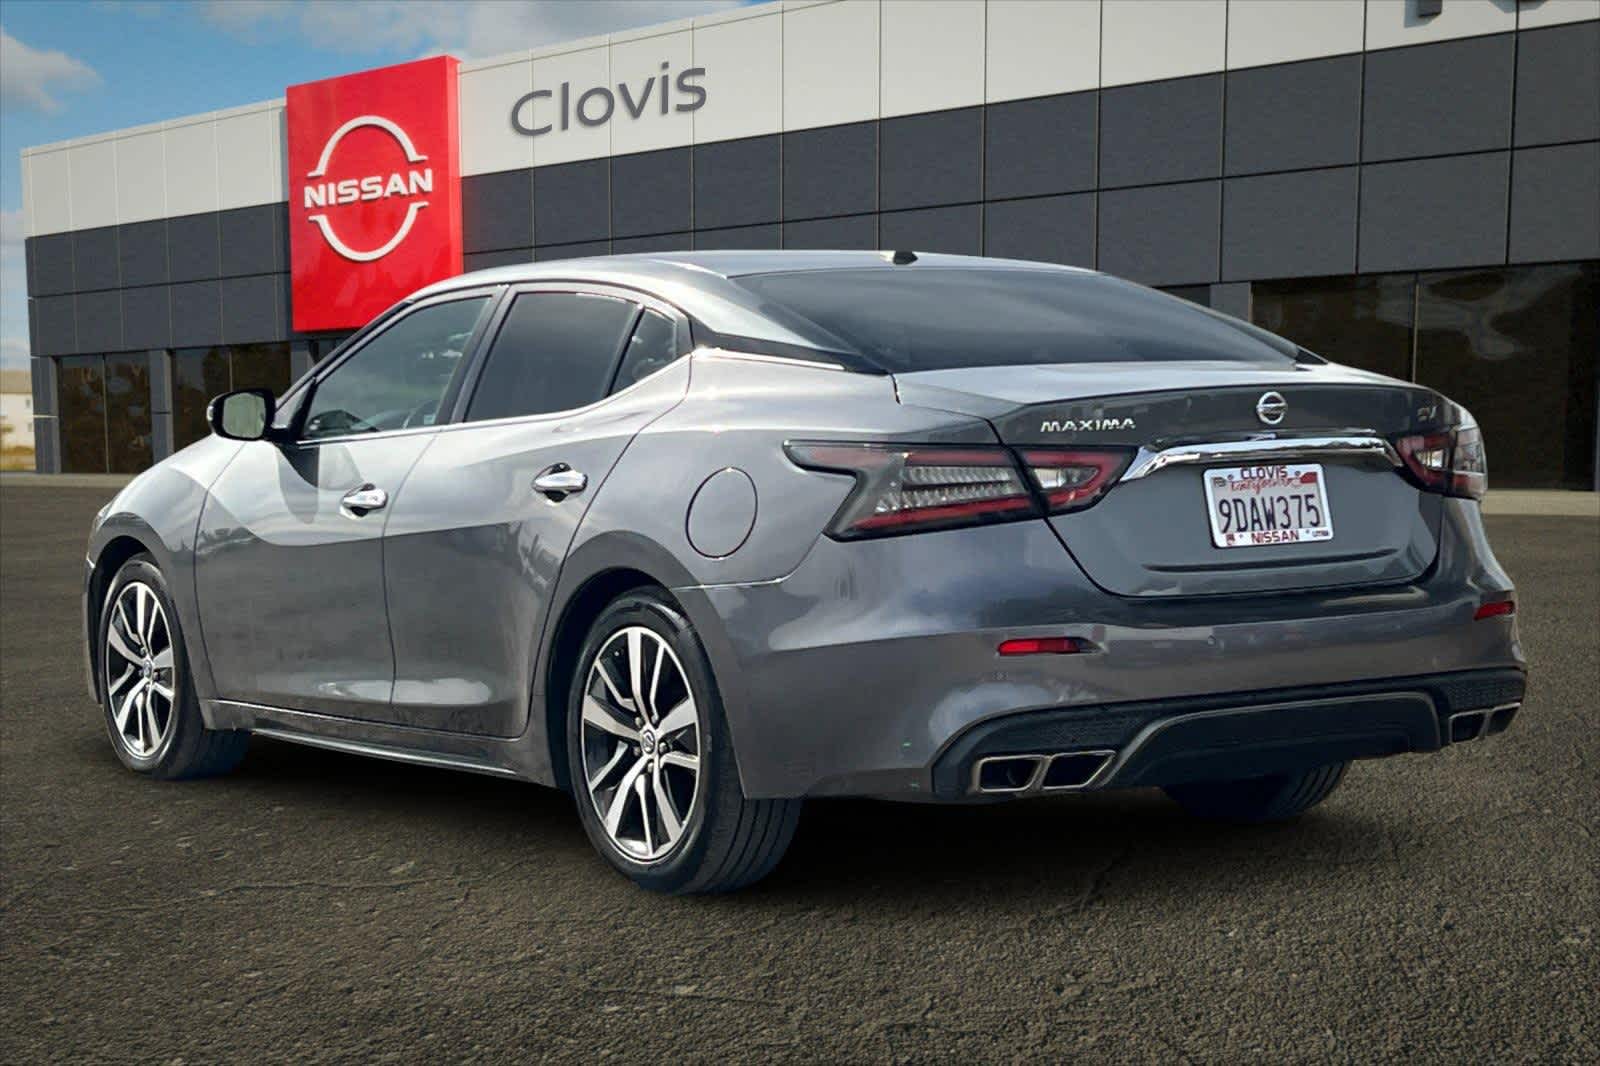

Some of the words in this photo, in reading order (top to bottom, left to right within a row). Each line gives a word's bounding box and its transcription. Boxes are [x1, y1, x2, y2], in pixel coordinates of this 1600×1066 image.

[511, 62, 707, 137] Clovis
[304, 169, 432, 208] NISSAN
[1041, 417, 1136, 433] MAXIMA
[1240, 466, 1288, 480] CLOVIS
[1219, 494, 1320, 533] 9DAW375
[1252, 530, 1299, 543] NISSAN
